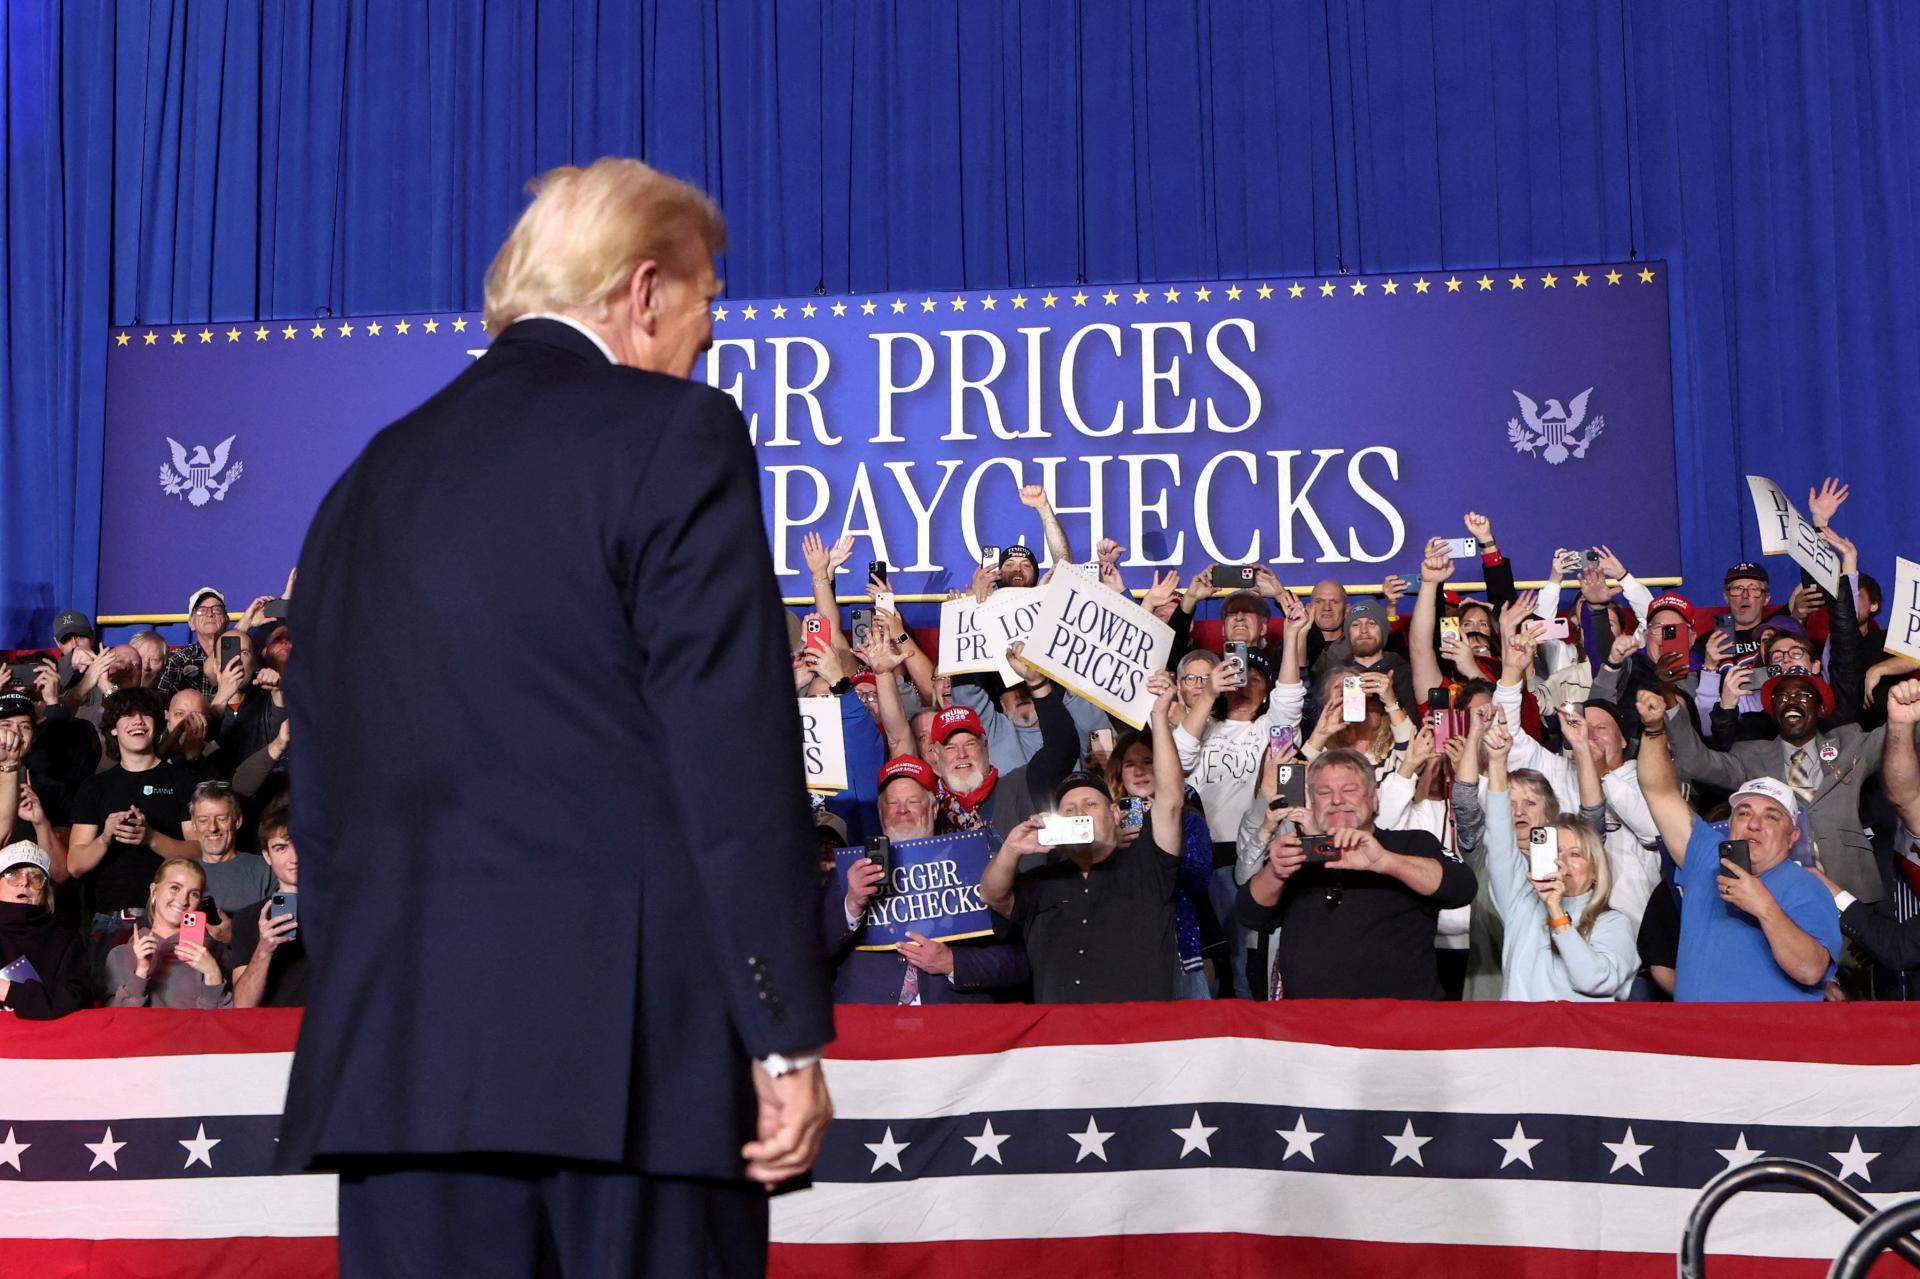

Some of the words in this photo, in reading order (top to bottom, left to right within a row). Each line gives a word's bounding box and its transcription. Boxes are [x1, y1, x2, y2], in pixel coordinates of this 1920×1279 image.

[869, 318, 1262, 444] PRICES
[765, 446, 1405, 575] PAYCHECKS
[1059, 588, 1154, 670] LOWER
[1736, 641, 1760, 654] ERI
[1045, 624, 1145, 703] PRICES
[940, 708, 970, 721] TRUMP
[1195, 746, 1258, 785] JESUS
[877, 859, 962, 896] GGER
